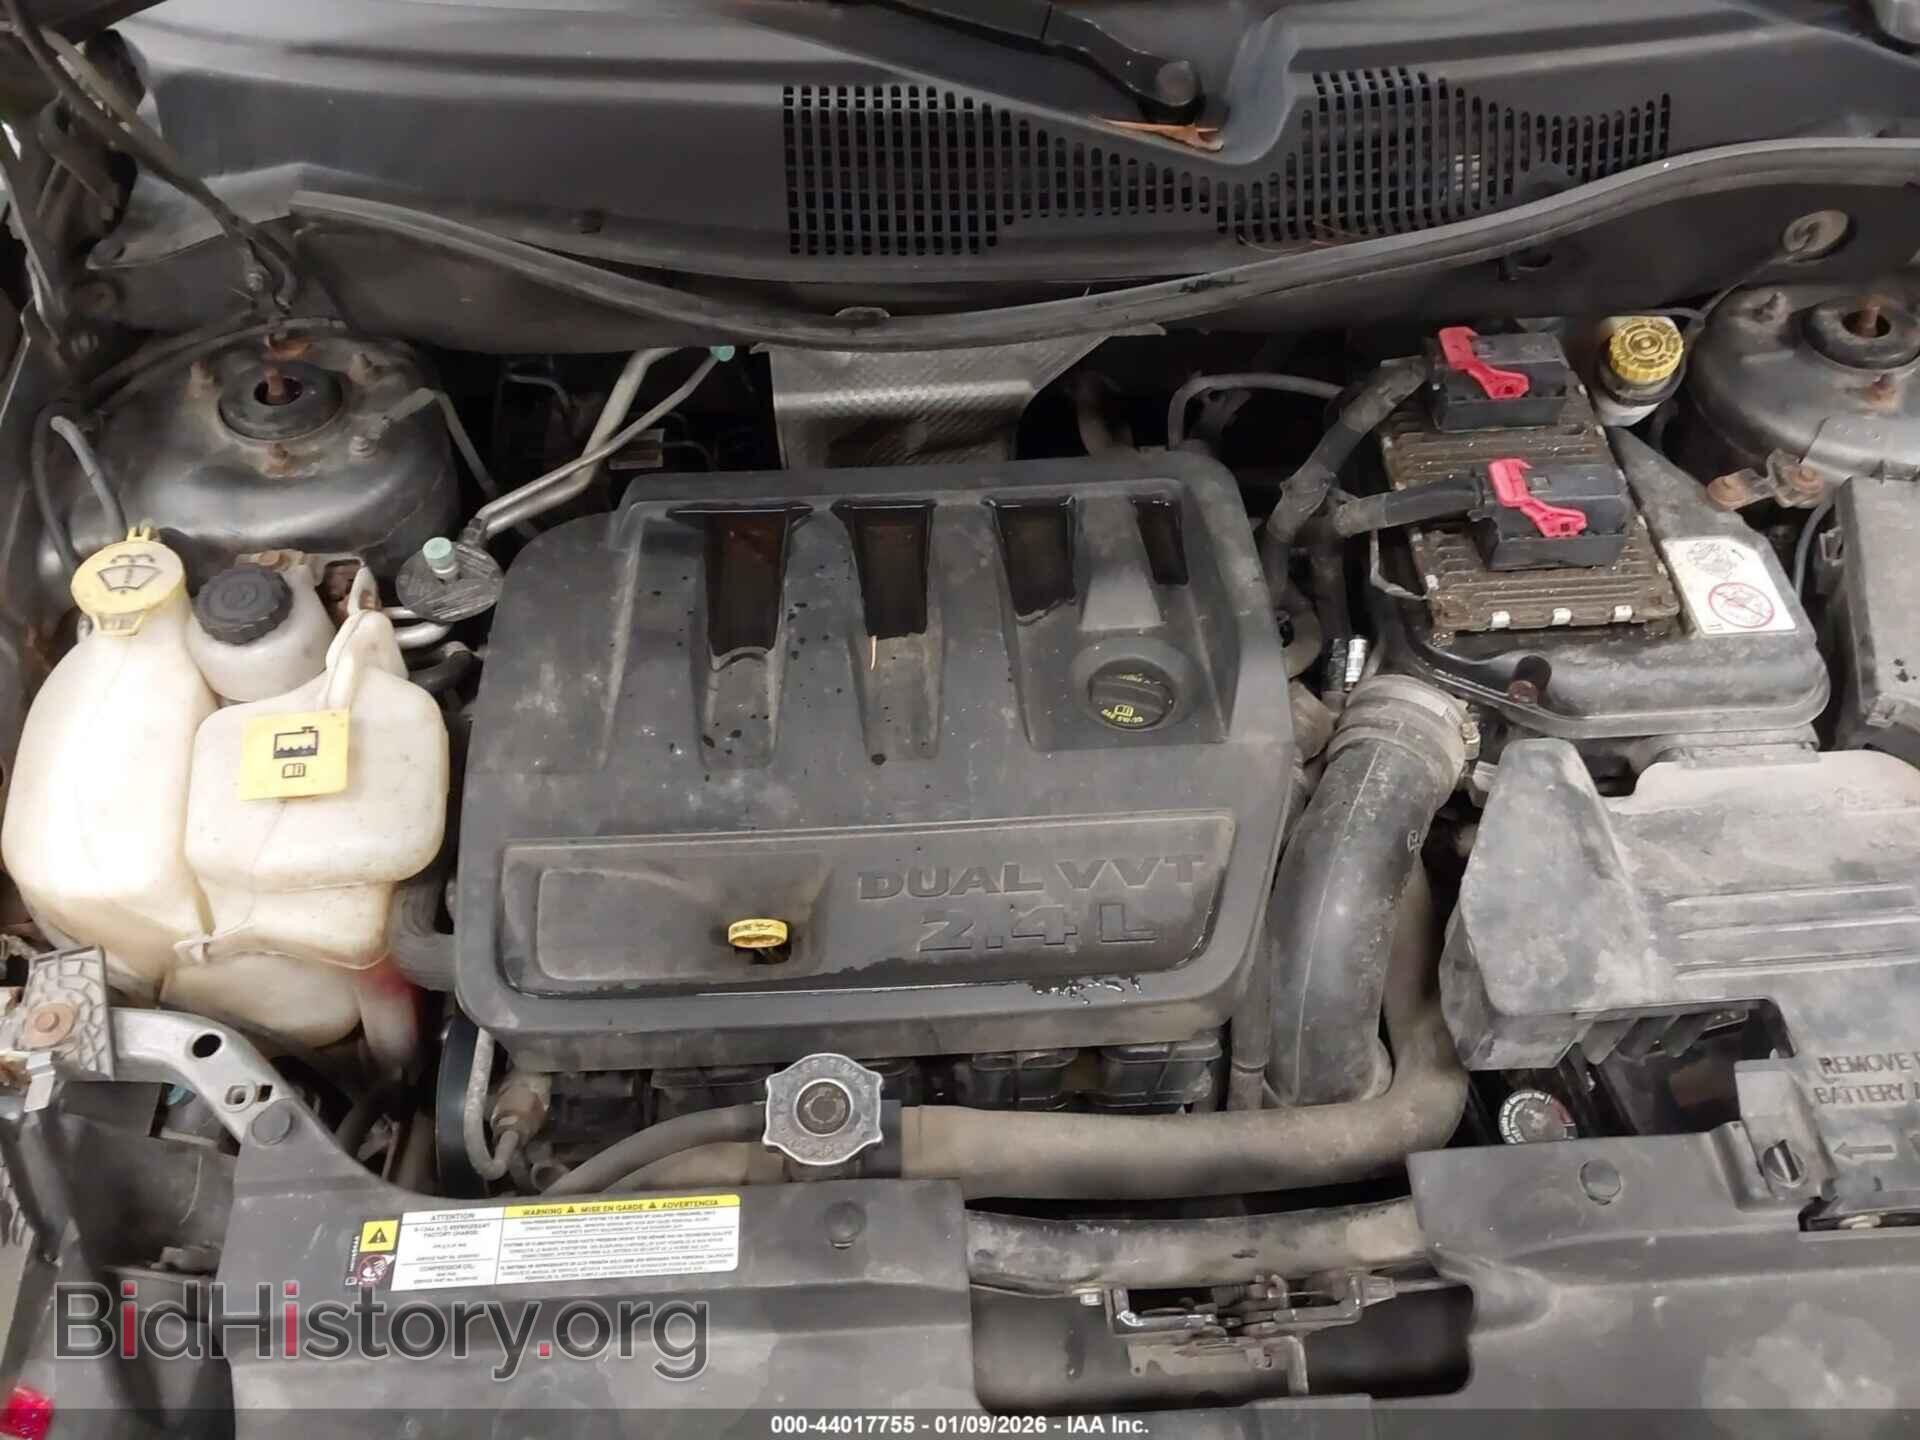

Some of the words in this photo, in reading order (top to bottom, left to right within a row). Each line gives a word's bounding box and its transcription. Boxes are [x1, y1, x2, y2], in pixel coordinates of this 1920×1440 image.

[857, 862, 1044, 900] DUAL
[1055, 855, 1205, 890] VVT
[1819, 1053, 1913, 1074] REMOVE
[1814, 1083, 1905, 1104] BATTERY
[431, 1212, 475, 1221] ATTENTION
[522, 1207, 562, 1215] WARNING
[616, 1203, 644, 1211] GARDE
[662, 1200, 718, 1209] ADVERTENCIA
